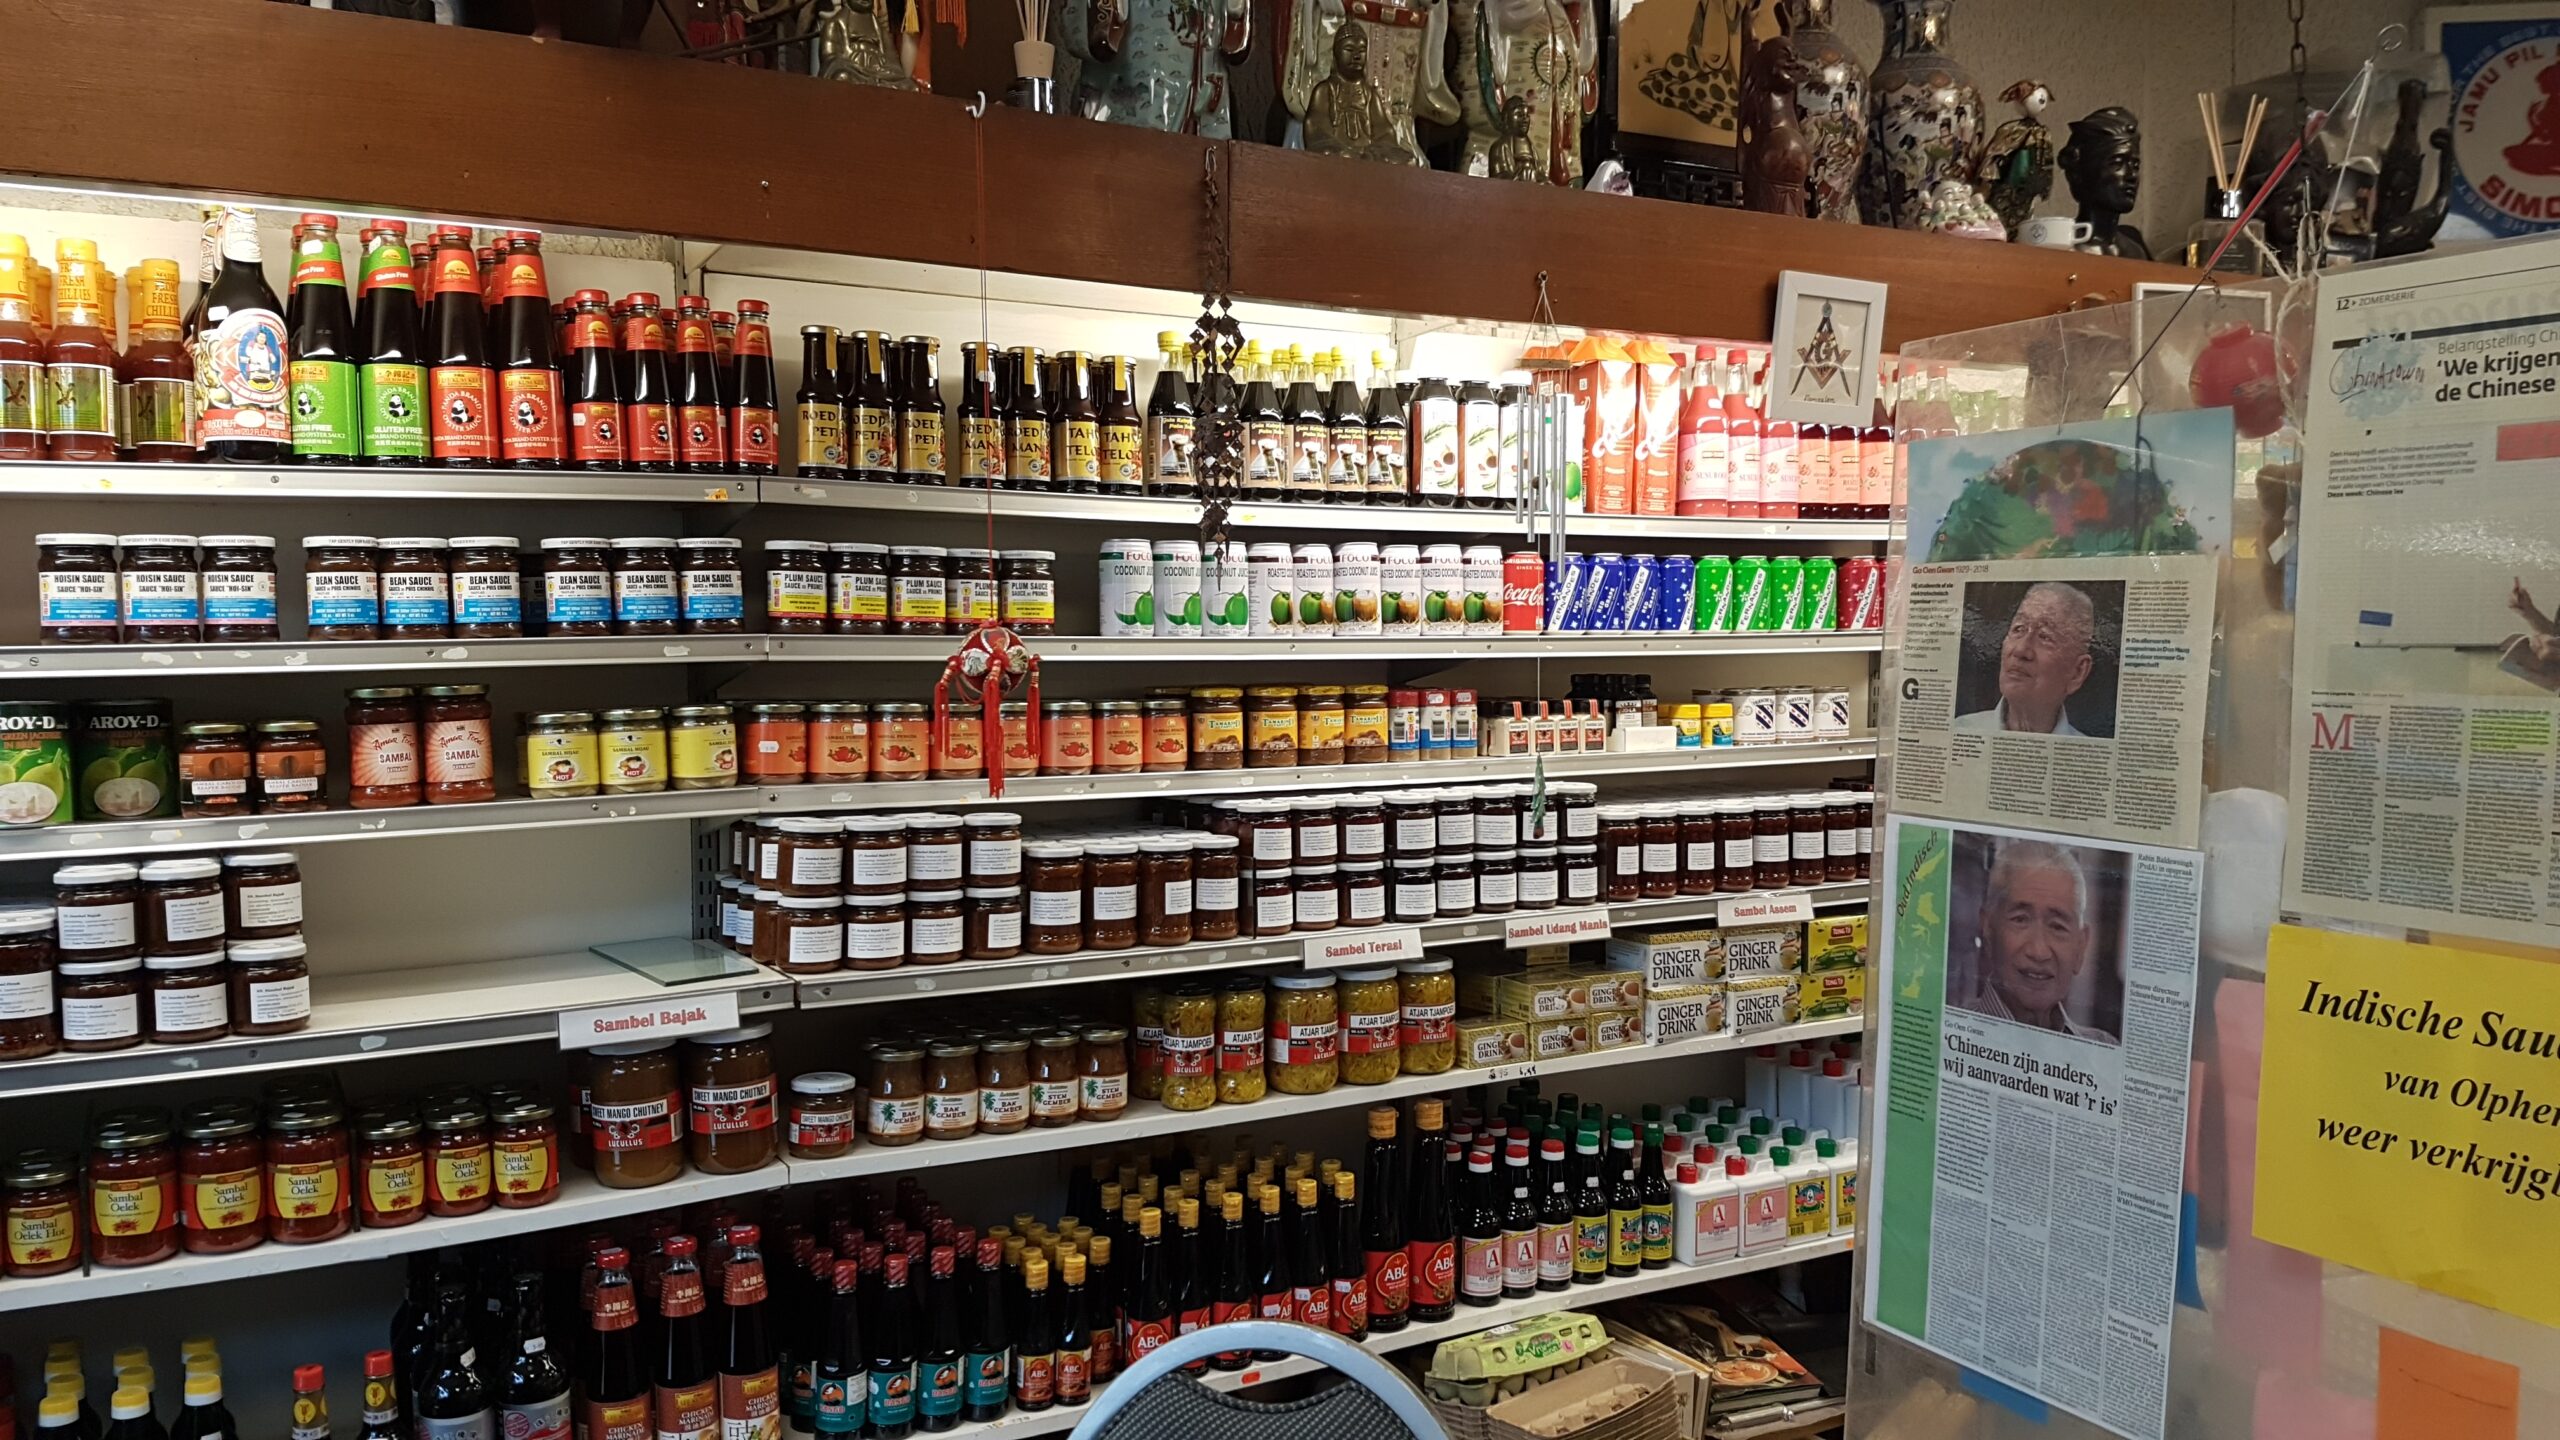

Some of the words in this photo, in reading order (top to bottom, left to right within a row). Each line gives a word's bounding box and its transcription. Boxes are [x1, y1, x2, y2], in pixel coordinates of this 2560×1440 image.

[2459, 67, 2499, 133] JAMU
[2505, 46, 2544, 68] PIL
[394, 271, 409, 279] Free
[2336, 298, 2349, 311] 12
[2358, 290, 2416, 306] ZOMERSERIE
[2438, 334, 2537, 355] Belangstelling
[2484, 351, 2560, 376] krijgen
[2436, 384, 2461, 402] de
[2468, 377, 2555, 400] Chinese
[442, 391, 460, 410] PANDA
[461, 391, 482, 410] BRAND
[527, 393, 548, 411] BRAND
[1341, 554, 1370, 562] FOCO
[1114, 566, 1145, 575] COCONUT
[1164, 567, 1194, 577] COCONUT
[1268, 568, 1286, 577] ROASTED
[1296, 570, 1317, 578] ROASTED
[1913, 566, 1922, 574] Go
[1923, 566, 1936, 574] Oen
[1937, 566, 1954, 574] Gwan
[54, 575, 80, 584] HOISIN
[136, 575, 161, 583] HOISIN
[208, 574, 229, 583] HOISIN
[316, 576, 333, 585] BEAN
[334, 575, 359, 585] SAUCE
[390, 577, 407, 585] BEAN
[408, 577, 432, 586] SAUCE
[470, 576, 485, 585] BEAN
[487, 575, 511, 585] SAUCE
[560, 576, 578, 584] BEAN
[627, 575, 644, 584] BEAN
[645, 575, 667, 584] SAUCE
[693, 575, 710, 583] BEAN
[712, 574, 732, 583] SAUCE
[784, 574, 803, 583] PLUM
[805, 574, 823, 583] SAUCE
[855, 576, 874, 585] PLUM
[906, 579, 924, 588] PLUM
[1011, 582, 1029, 590] PLUM
[1503, 583, 1543, 606] Coca-Co
[1740, 572, 1763, 625] FERNANDES
[1856, 572, 1876, 623] FERNANDES
[1902, 677, 1919, 700] G
[0, 716, 56, 730] ROY-D
[90, 715, 159, 728] AROY-D
[2311, 712, 2356, 750] M
[379, 753, 412, 763] SAMBAL
[445, 750, 480, 760] SAMBAL
[1734, 906, 1767, 917] Sambel
[1769, 903, 1797, 915] Assem
[1509, 926, 1543, 938] Sambel
[1547, 923, 1577, 935] Udang
[1580, 918, 1608, 928] Manis
[1325, 942, 1366, 957] Sambel
[1369, 939, 1402, 955] Terasi
[1729, 941, 1778, 958] GINGER
[1653, 949, 1701, 966] GINGER
[1729, 956, 1771, 971] DRINK
[1653, 965, 1695, 980] DRINK
[1736, 994, 1780, 1012] GINGER
[1409, 1008, 1428, 1017] ATJAR
[1658, 1003, 1703, 1021] GINGER
[2299, 980, 2463, 1040] Indische
[593, 1015, 655, 1033] Sambel
[660, 1008, 707, 1028] Bajak
[1359, 1017, 1377, 1026] ATJAR
[1737, 1010, 1774, 1026] DRINK
[1658, 1019, 1697, 1036] DRINK
[1181, 1038, 1212, 1048] TJAMPOER
[2013, 1052, 2039, 1074] zijn
[2043, 1061, 2098, 1091] anders,
[1944, 1057, 1964, 1078] wij
[1968, 1065, 2049, 1099] aanvaarden
[2053, 1087, 2079, 1107] wat
[2384, 1071, 2440, 1100] van
[712, 1088, 737, 1101] MANGO
[739, 1085, 769, 1099] CHUTNEY
[1097, 1091, 1123, 1100] GEMBER
[1042, 1098, 1071, 1106] GEMBER
[606, 1106, 631, 1118] MANGO
[632, 1102, 664, 1116] CHUTNEY
[713, 1120, 749, 1130] LUCULLUS
[2317, 1117, 2397, 1153] weer
[608, 1138, 643, 1147] LUCULLUS
[451, 1158, 482, 1170] Sambal
[502, 1153, 533, 1164] Sambal
[505, 1161, 530, 1171] Oelek
[384, 1168, 415, 1180] Sambal
[454, 1167, 479, 1178] Oelek
[288, 1175, 322, 1186] Sambal
[387, 1177, 414, 1188] Oelek
[214, 1184, 248, 1196] Sambal
[291, 1184, 319, 1195] Oelek
[108, 1192, 143, 1202] Sambal
[217, 1194, 244, 1205] Oelek
[110, 1202, 139, 1212] Oelek
[1762, 1197, 1773, 1215] A
[1713, 1204, 1725, 1222] A
[21, 1221, 58, 1230] Sambal
[14, 1229, 42, 1240] Oelek
[46, 1226, 66, 1237] Hot
[1385, 1268, 1409, 1281] ABC
[1310, 1301, 1329, 1313] ABC
[1137, 1336, 1163, 1348] ABC
[1031, 1369, 1047, 1378] ABC
[1063, 1364, 1079, 1373] ABC
[681, 1406, 712, 1418] CHICKEN
[679, 1412, 714, 1425] MARINADE
[608, 1422, 642, 1433] CHICKEN
[606, 1428, 644, 1440] MARINADE
